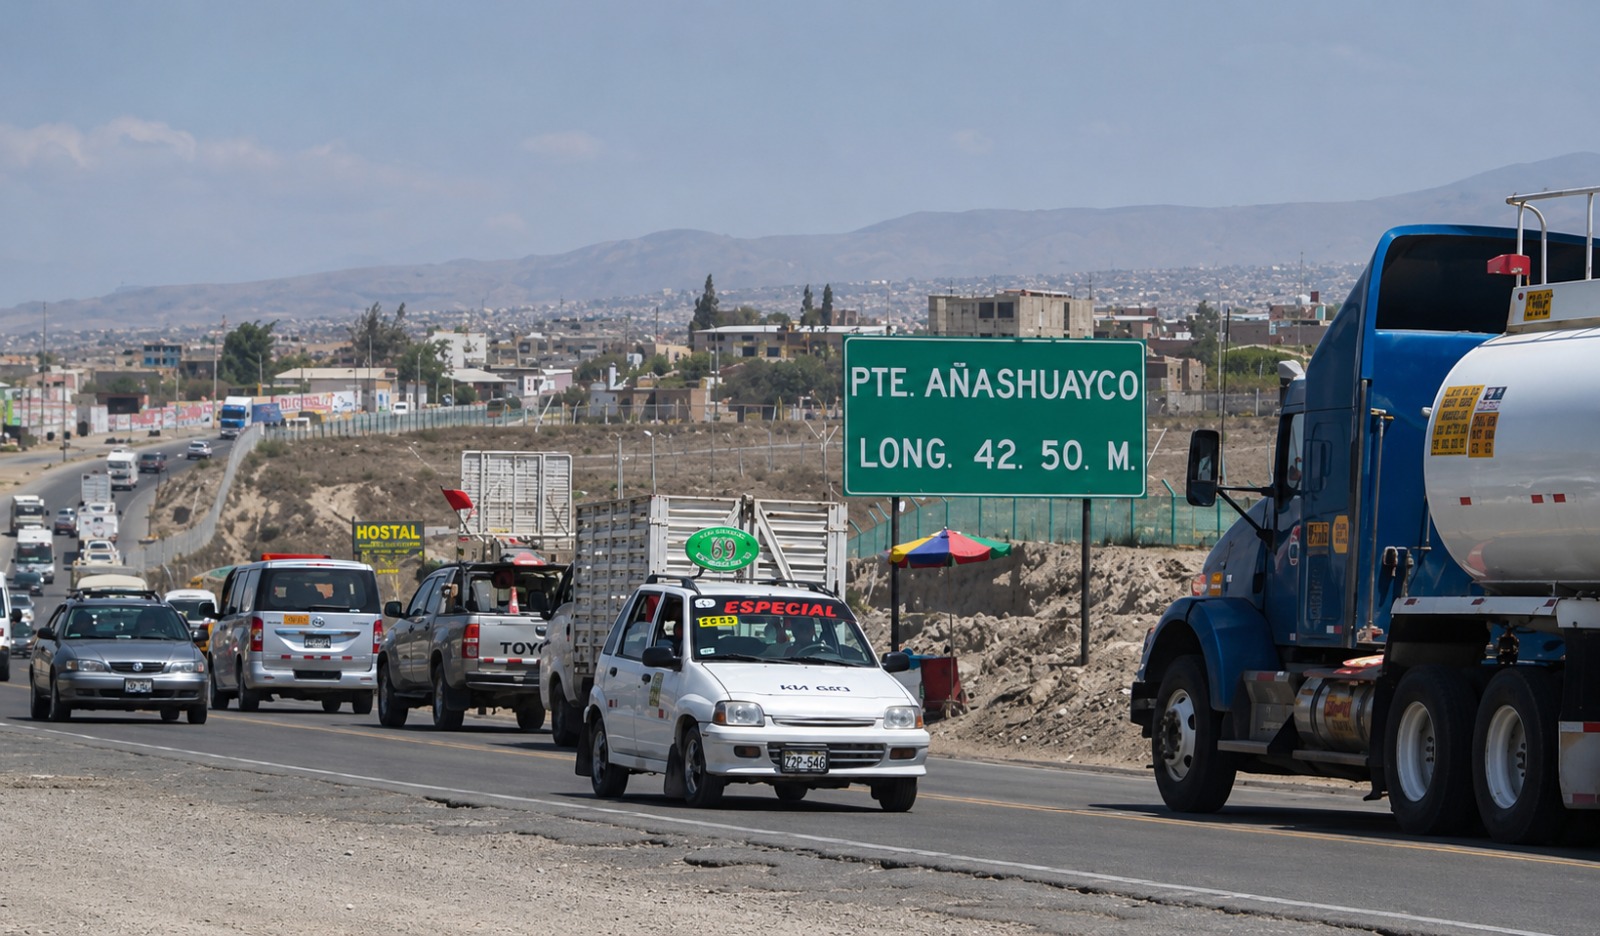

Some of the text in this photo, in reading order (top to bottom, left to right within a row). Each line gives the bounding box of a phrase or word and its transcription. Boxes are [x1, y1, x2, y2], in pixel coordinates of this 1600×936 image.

[851, 362, 1139, 401] PTE. AÑASHUAYCO
[860, 437, 1136, 472] LONG. 42. 50. M.
[356, 524, 421, 540] HOSTAL
[711, 537, 737, 561] 69
[723, 600, 837, 618] ESPECIAL
